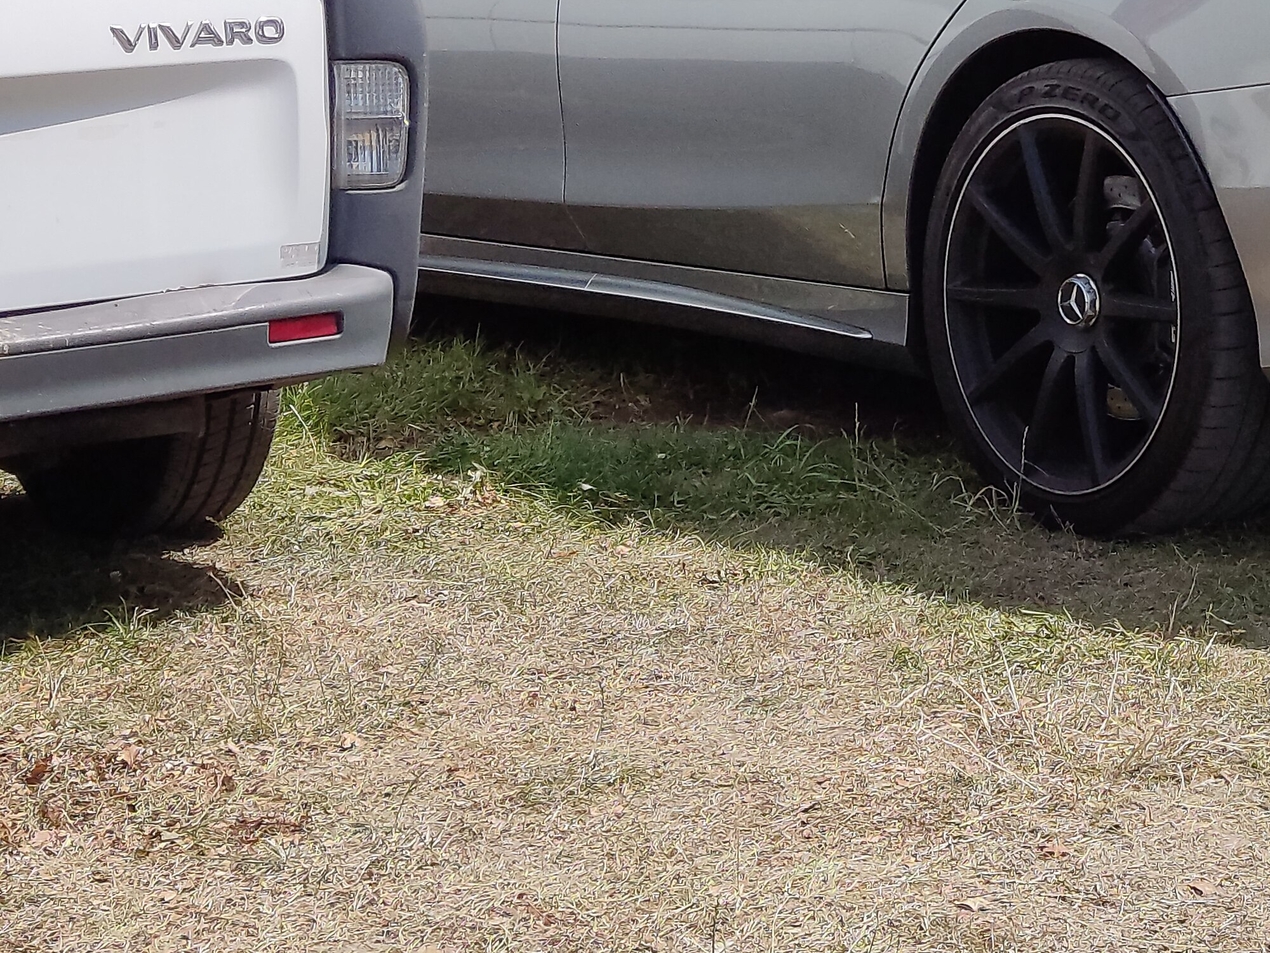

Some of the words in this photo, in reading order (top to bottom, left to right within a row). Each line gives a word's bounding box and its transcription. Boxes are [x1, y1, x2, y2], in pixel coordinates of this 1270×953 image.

[110, 15, 287, 54] VIVARO
[1017, 85, 1036, 104] P
[1041, 83, 1122, 122] ZERO
